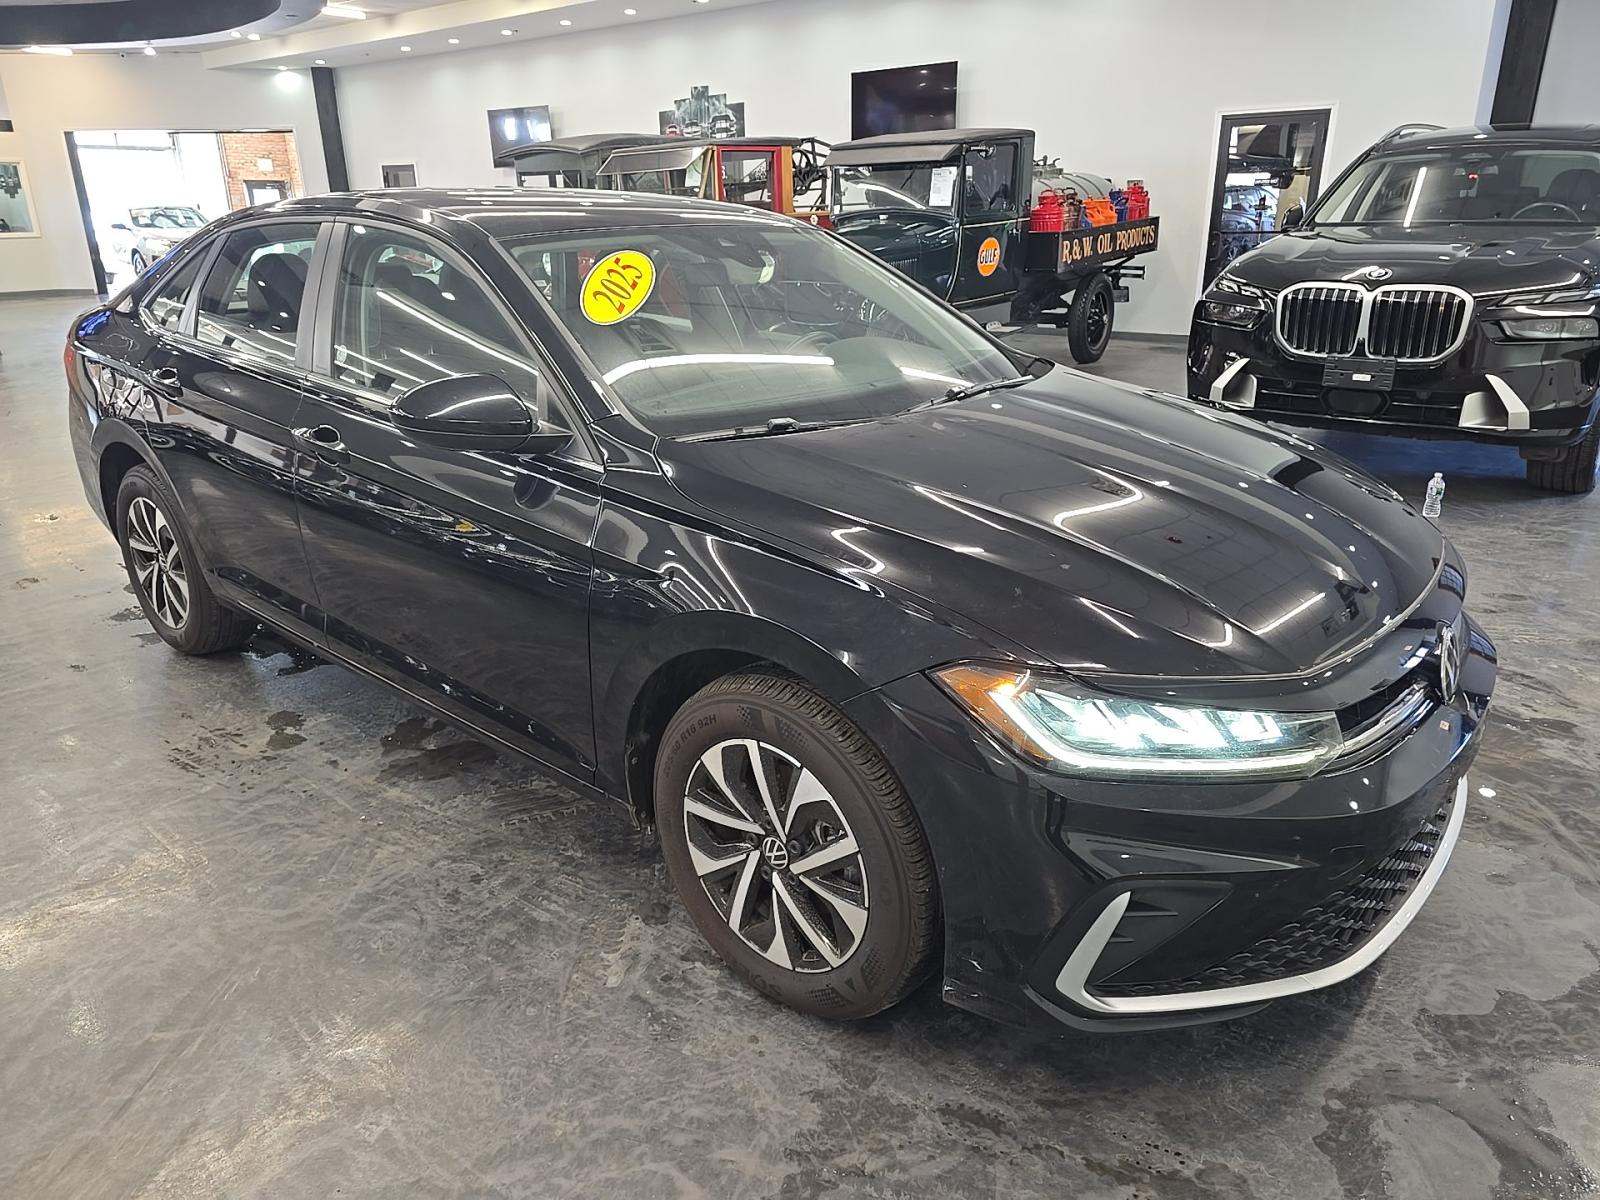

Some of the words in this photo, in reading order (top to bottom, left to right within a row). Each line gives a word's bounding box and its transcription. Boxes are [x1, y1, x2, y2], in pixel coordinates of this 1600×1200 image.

[1097, 233, 1113, 254] OIL
[1116, 225, 1155, 251] PRODUCTS
[980, 248, 998, 264] GULF
[593, 257, 642, 314] 2025
